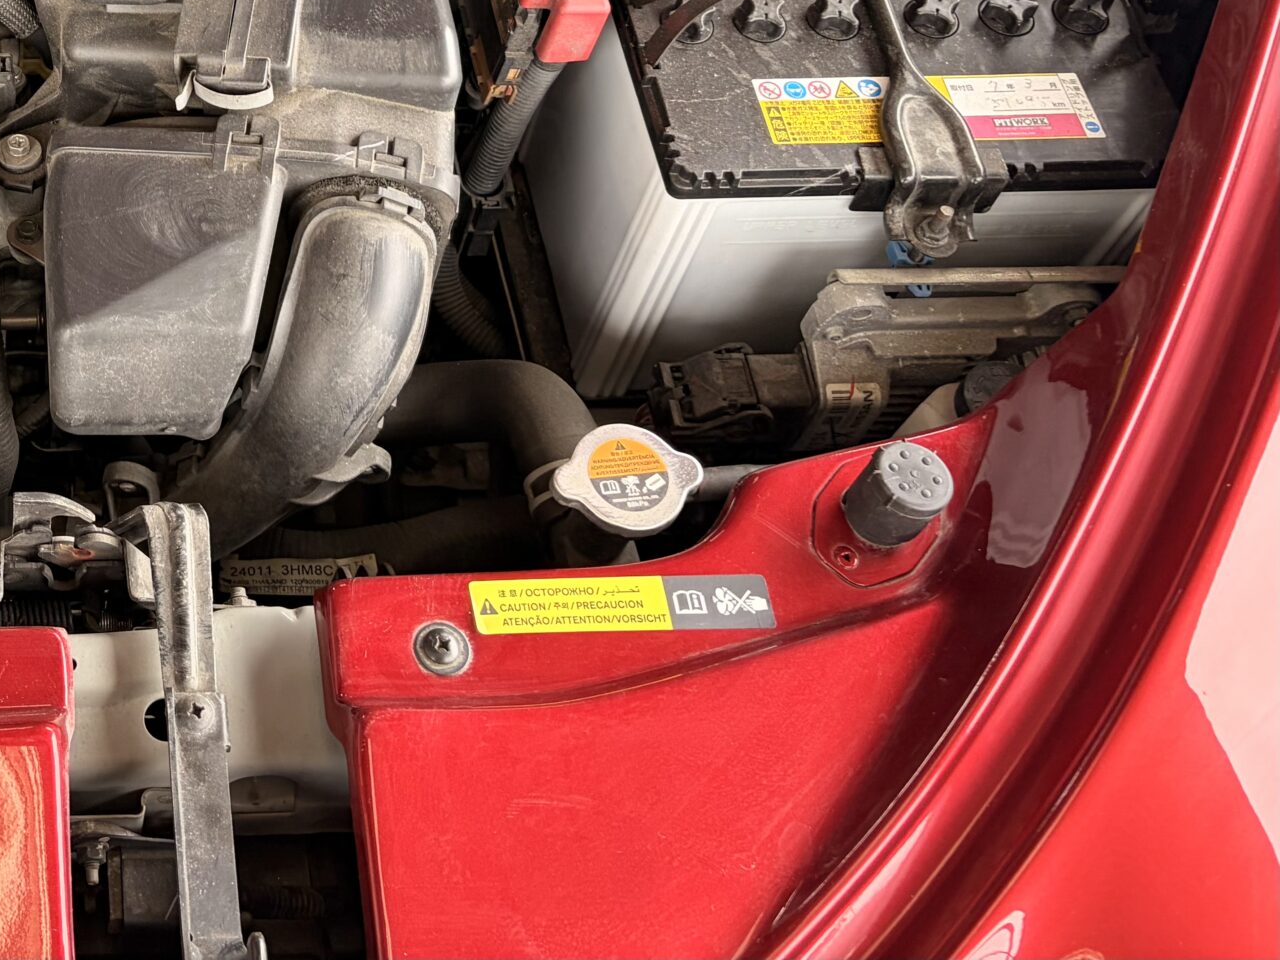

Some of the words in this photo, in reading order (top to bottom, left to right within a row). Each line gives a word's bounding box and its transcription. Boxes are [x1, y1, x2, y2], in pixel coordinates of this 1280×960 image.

[230, 566, 271, 577] 24011
[281, 564, 334, 576] 3HM8C
[525, 586, 595, 597] ОСТОРОЖНО
[603, 585, 641, 596] تحذير
[499, 602, 546, 612] CAUTION
[553, 602, 569, 611] 주의
[576, 600, 644, 610] PRECAUCION
